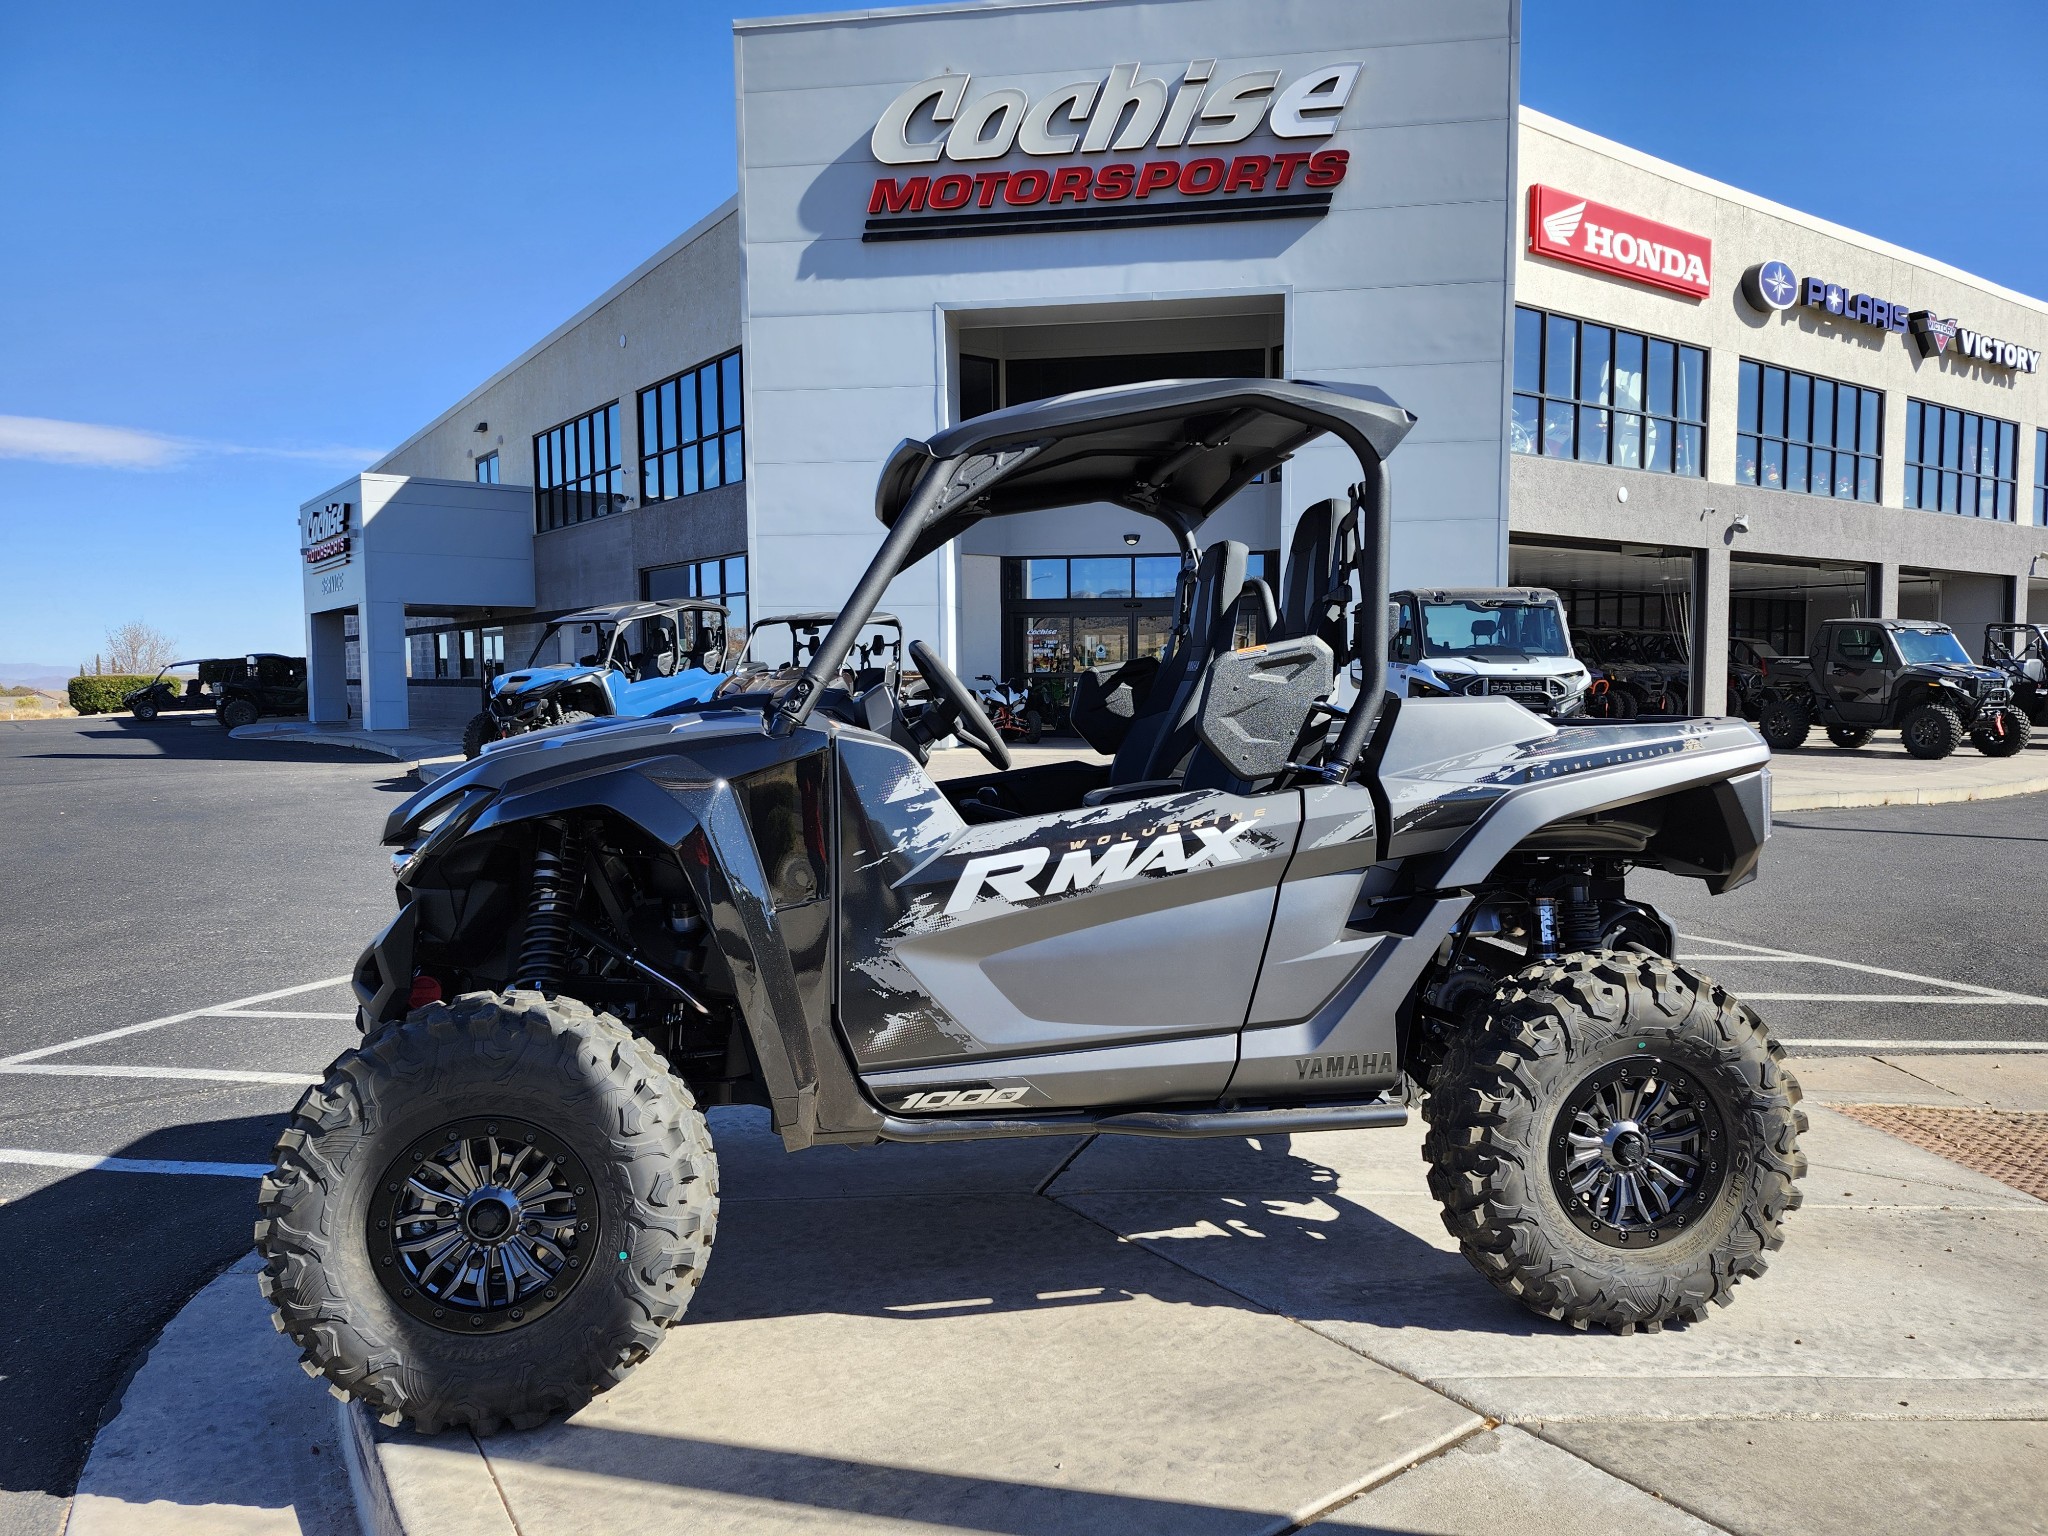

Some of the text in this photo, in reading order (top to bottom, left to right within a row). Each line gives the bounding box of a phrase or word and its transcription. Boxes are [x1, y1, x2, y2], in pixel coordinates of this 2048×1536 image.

[871, 58, 1365, 164] Cochise
[867, 149, 1350, 213] MOTORSPORTS
[1584, 221, 1709, 287] HONDA
[1805, 277, 1909, 333] POLARIS
[1927, 320, 1957, 337] VICTORY
[1960, 329, 2041, 373] VICTORY
[306, 503, 346, 546] Cochise
[306, 537, 346, 563] MOTORSPORTS
[1490, 684, 1543, 693] POLARIS
[1529, 747, 1675, 778] XTREME TERRAIN
[943, 818, 1261, 915] RMAX
[1295, 1051, 1393, 1080] YAMAHA
[900, 1086, 1031, 1110] 1000
